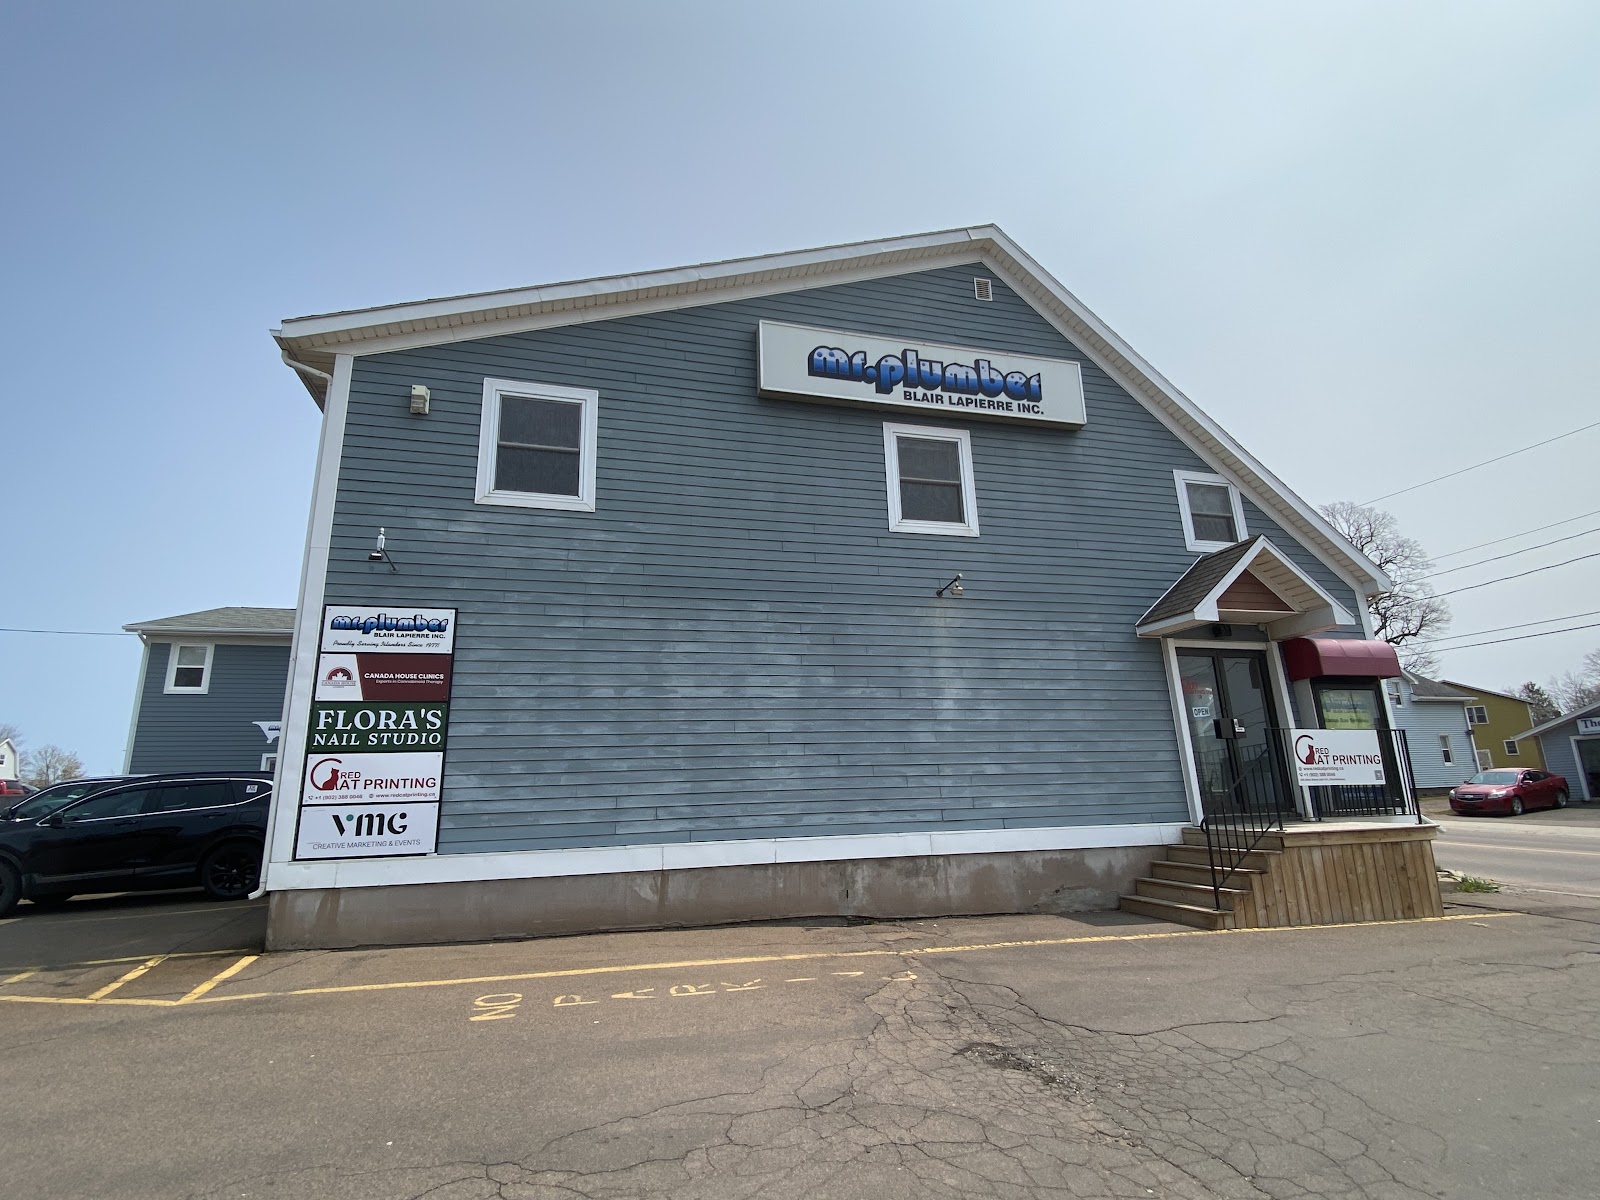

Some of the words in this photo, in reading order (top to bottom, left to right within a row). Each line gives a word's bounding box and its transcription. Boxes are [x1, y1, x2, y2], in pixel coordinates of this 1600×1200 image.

[903, 390, 944, 405] BLAIR
[948, 394, 1013, 412] LAPIERRE
[1017, 402, 1045, 415] INC.
[357, 640, 380, 648] Serving
[1194, 708, 1209, 716] OPEN
[316, 709, 442, 730] FLORA'S
[313, 733, 360, 746] NAIL
[367, 732, 441, 745] STUDIO
[1315, 747, 1329, 755] RED
[1333, 754, 1381, 765] PRINTING
[340, 771, 361, 779] RED
[363, 777, 436, 790] PRINTING
[346, 841, 387, 849] MARKETING
